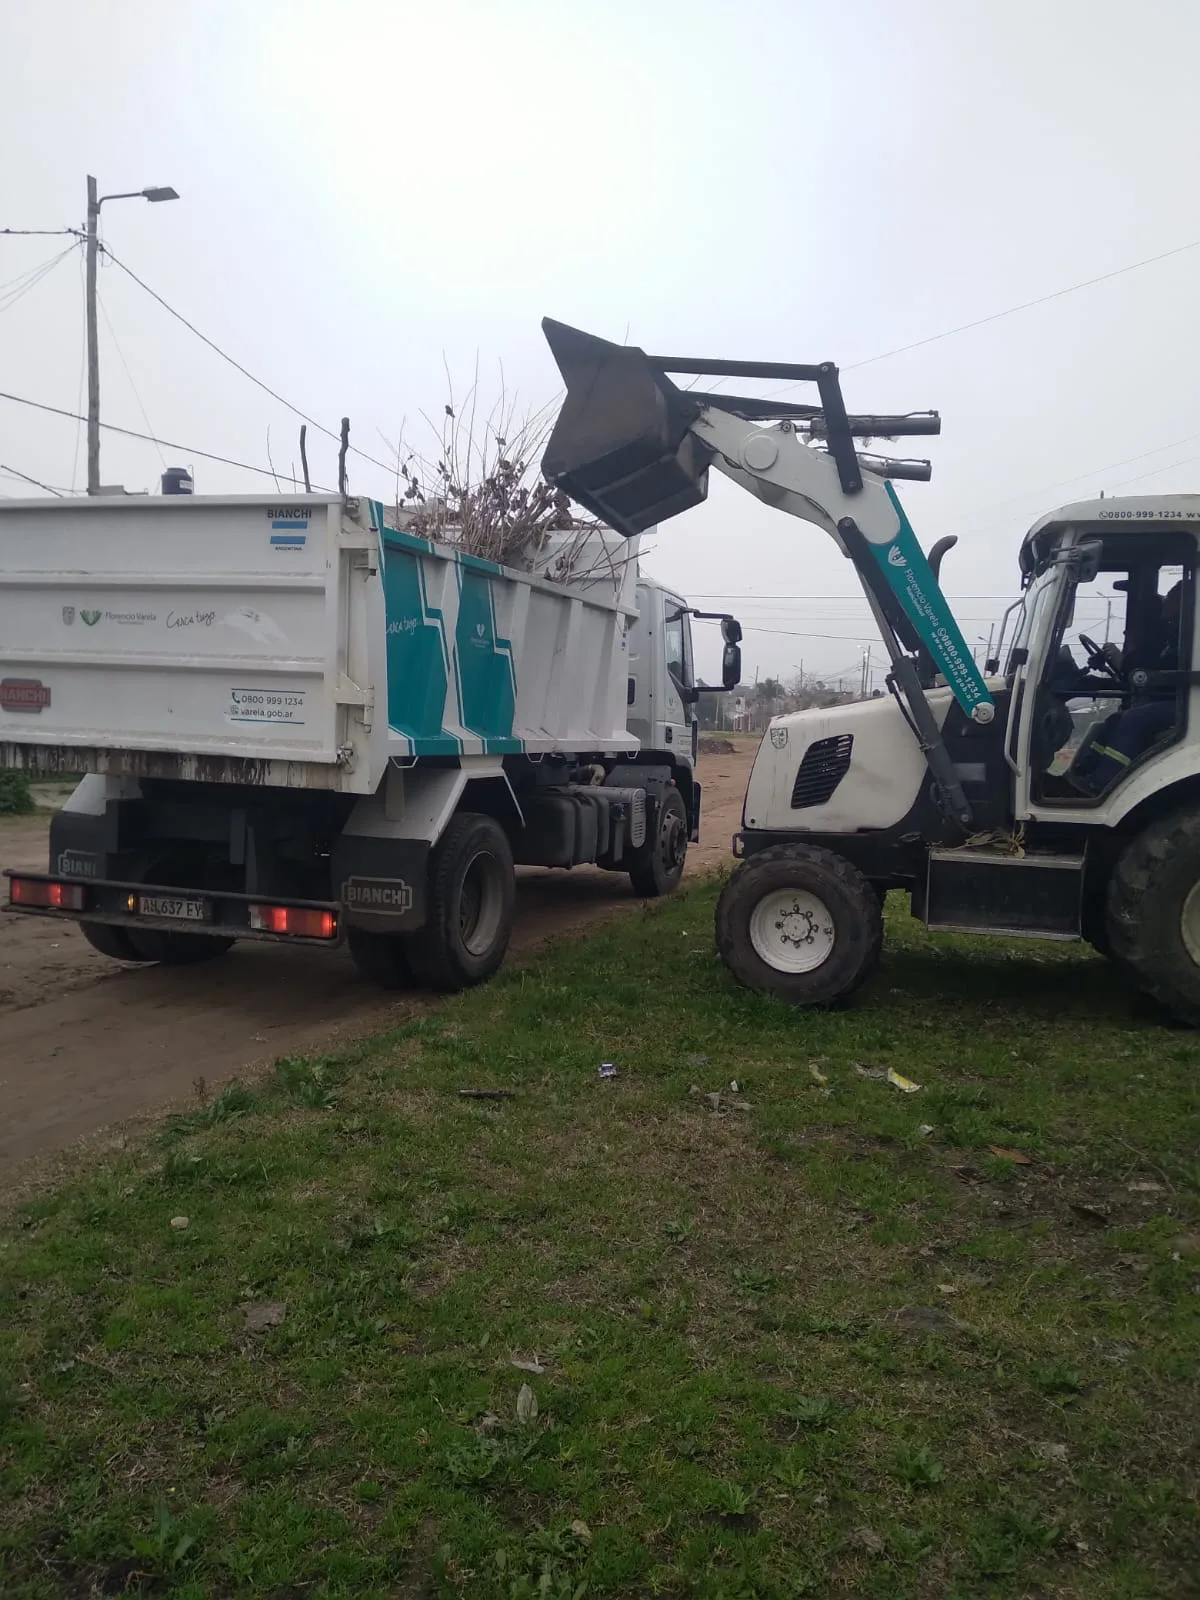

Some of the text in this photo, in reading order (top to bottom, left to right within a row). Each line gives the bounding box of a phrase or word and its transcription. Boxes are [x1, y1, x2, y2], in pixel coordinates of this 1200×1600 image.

[267, 508, 312, 519] BIANCHI
[1108, 510, 1182, 519] 0800-999-1234
[905, 568, 939, 627] Florencio Varela
[105, 611, 157, 621] Florencio Varela
[241, 695, 303, 706] 0800 999 1234
[347, 887, 406, 905] BIANCHI
